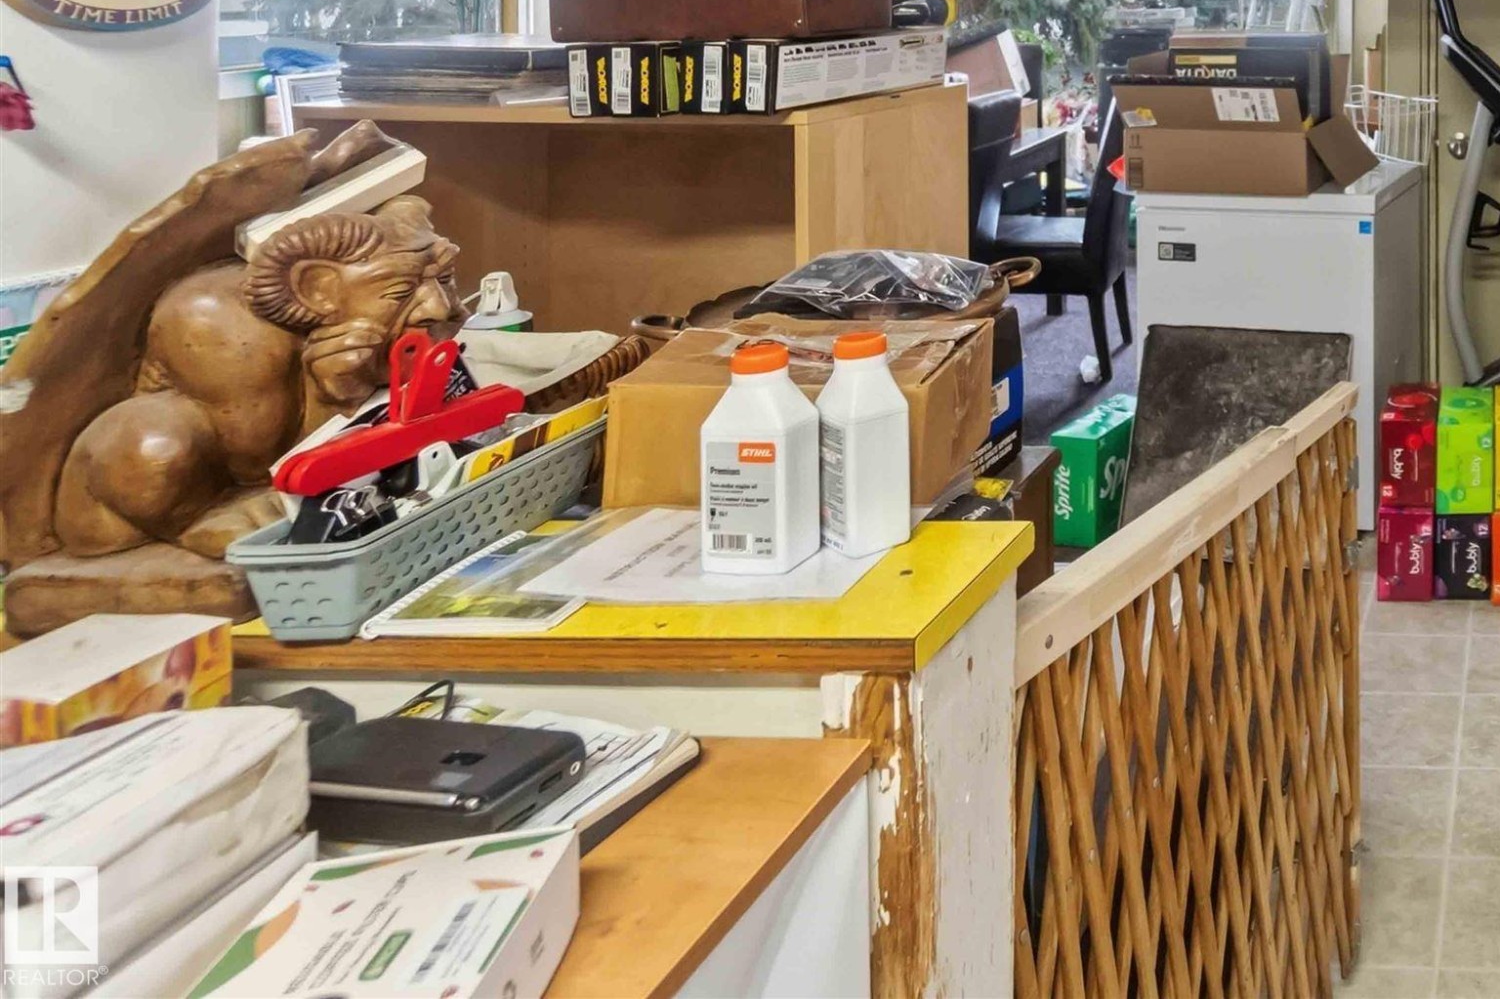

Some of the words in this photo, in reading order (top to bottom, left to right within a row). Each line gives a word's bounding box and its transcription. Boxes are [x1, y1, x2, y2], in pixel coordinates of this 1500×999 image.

[126, 1, 184, 25] LIMIT
[740, 448, 773, 457] STIHL
[1390, 448, 1404, 479] bubly
[1054, 464, 1073, 520] Sprite
[1382, 485, 1393, 497] 12
[1478, 524, 1488, 535] 12
[1409, 542, 1421, 574] bubly
[1466, 542, 1480, 574] bubly
